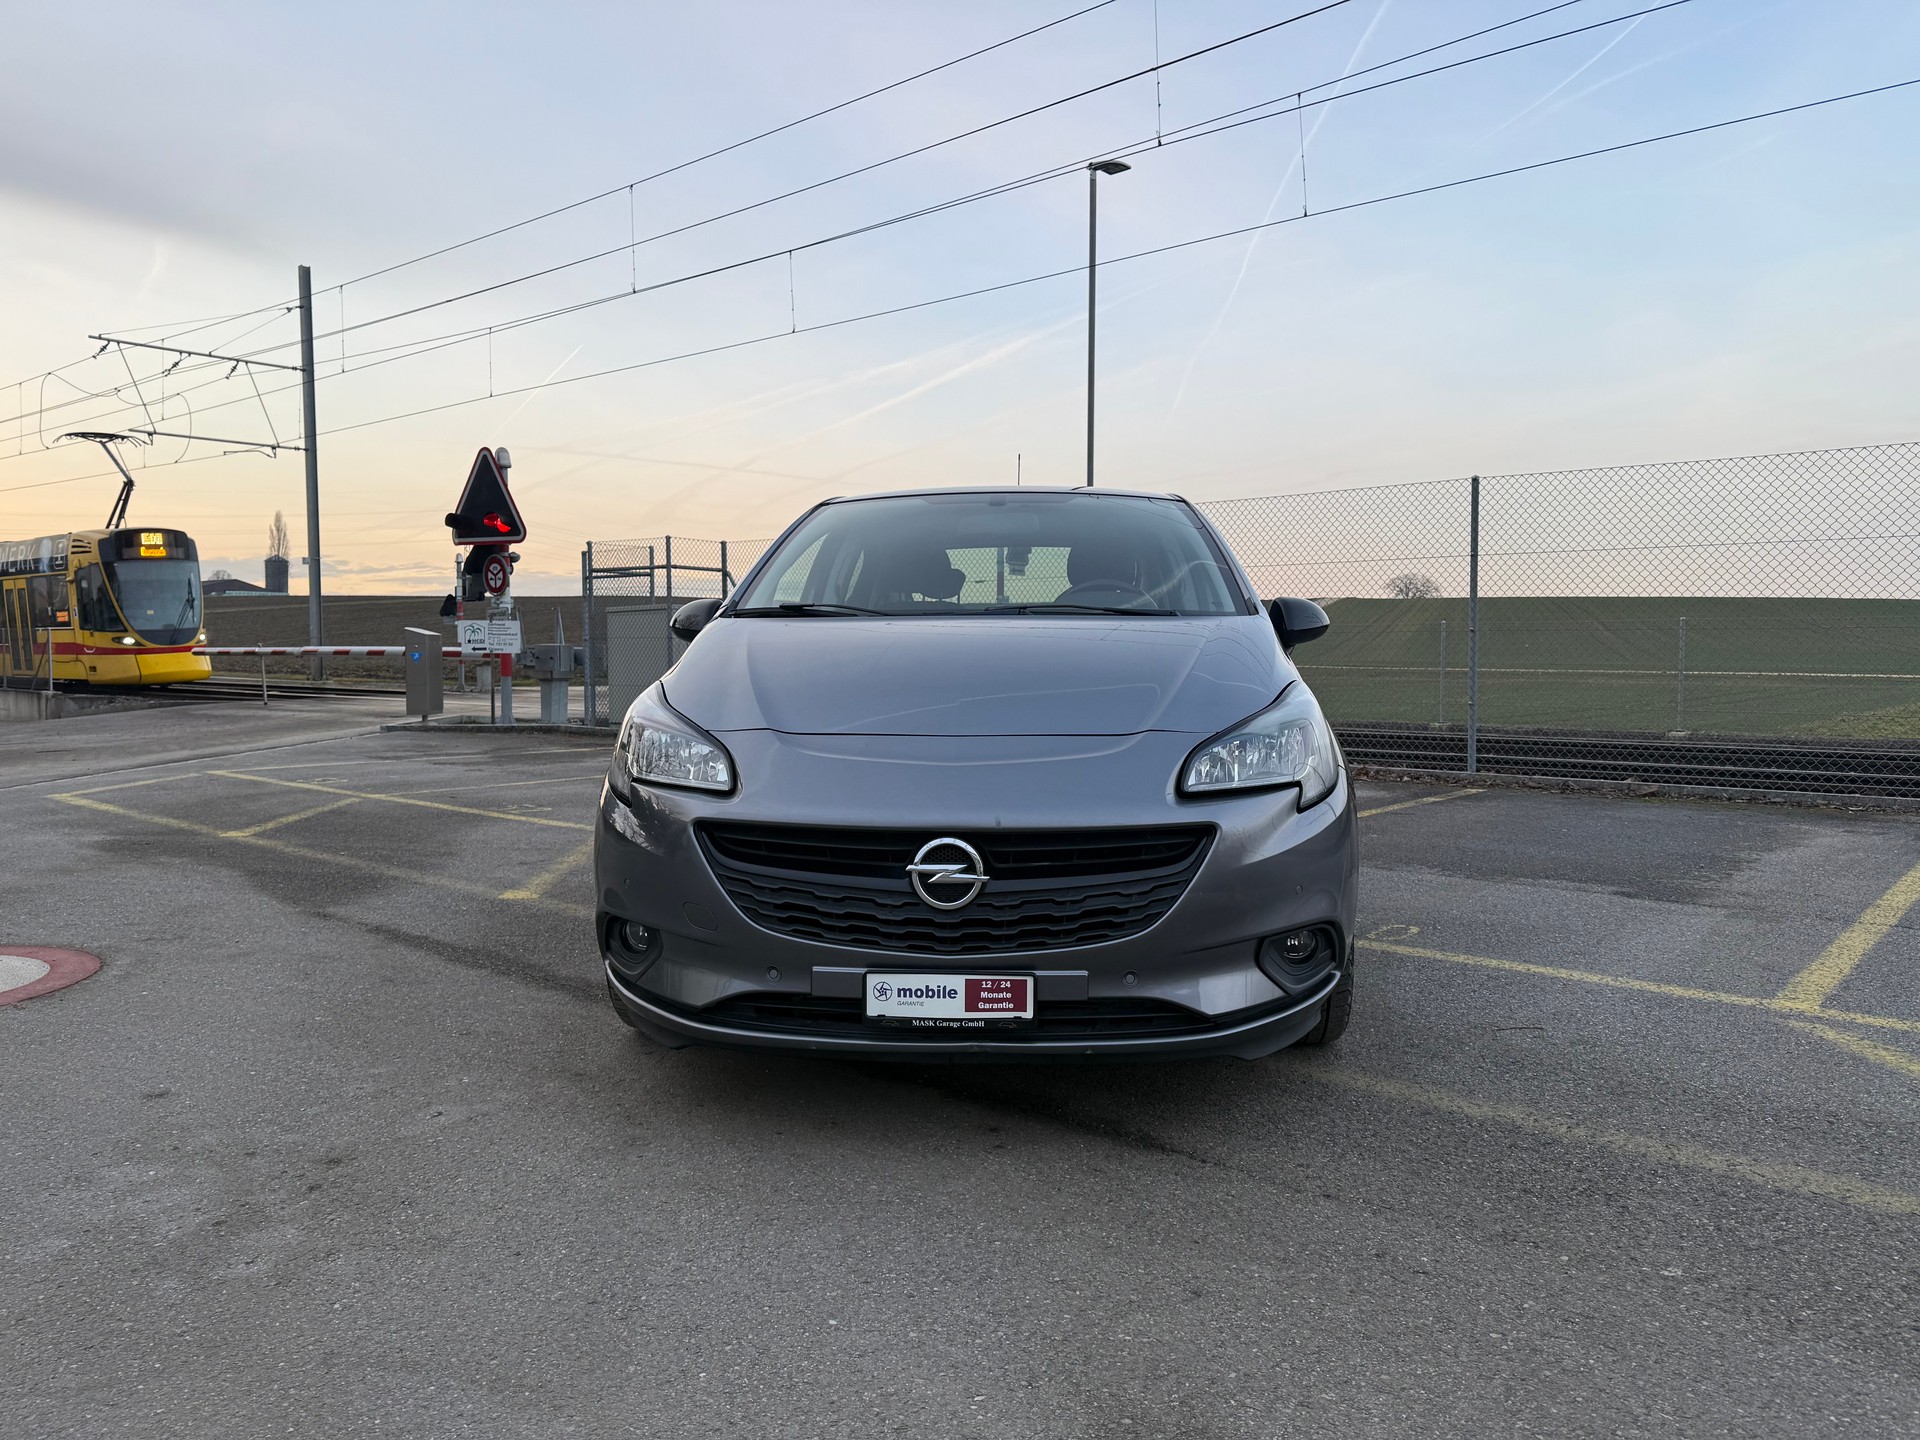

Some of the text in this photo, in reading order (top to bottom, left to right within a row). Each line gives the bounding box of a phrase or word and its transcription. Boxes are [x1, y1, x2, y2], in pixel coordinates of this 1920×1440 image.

[993, 981, 998, 989] /
[896, 984, 958, 999] mobile
[980, 991, 1012, 999] Monate
[936, 1020, 961, 1028] Garage
